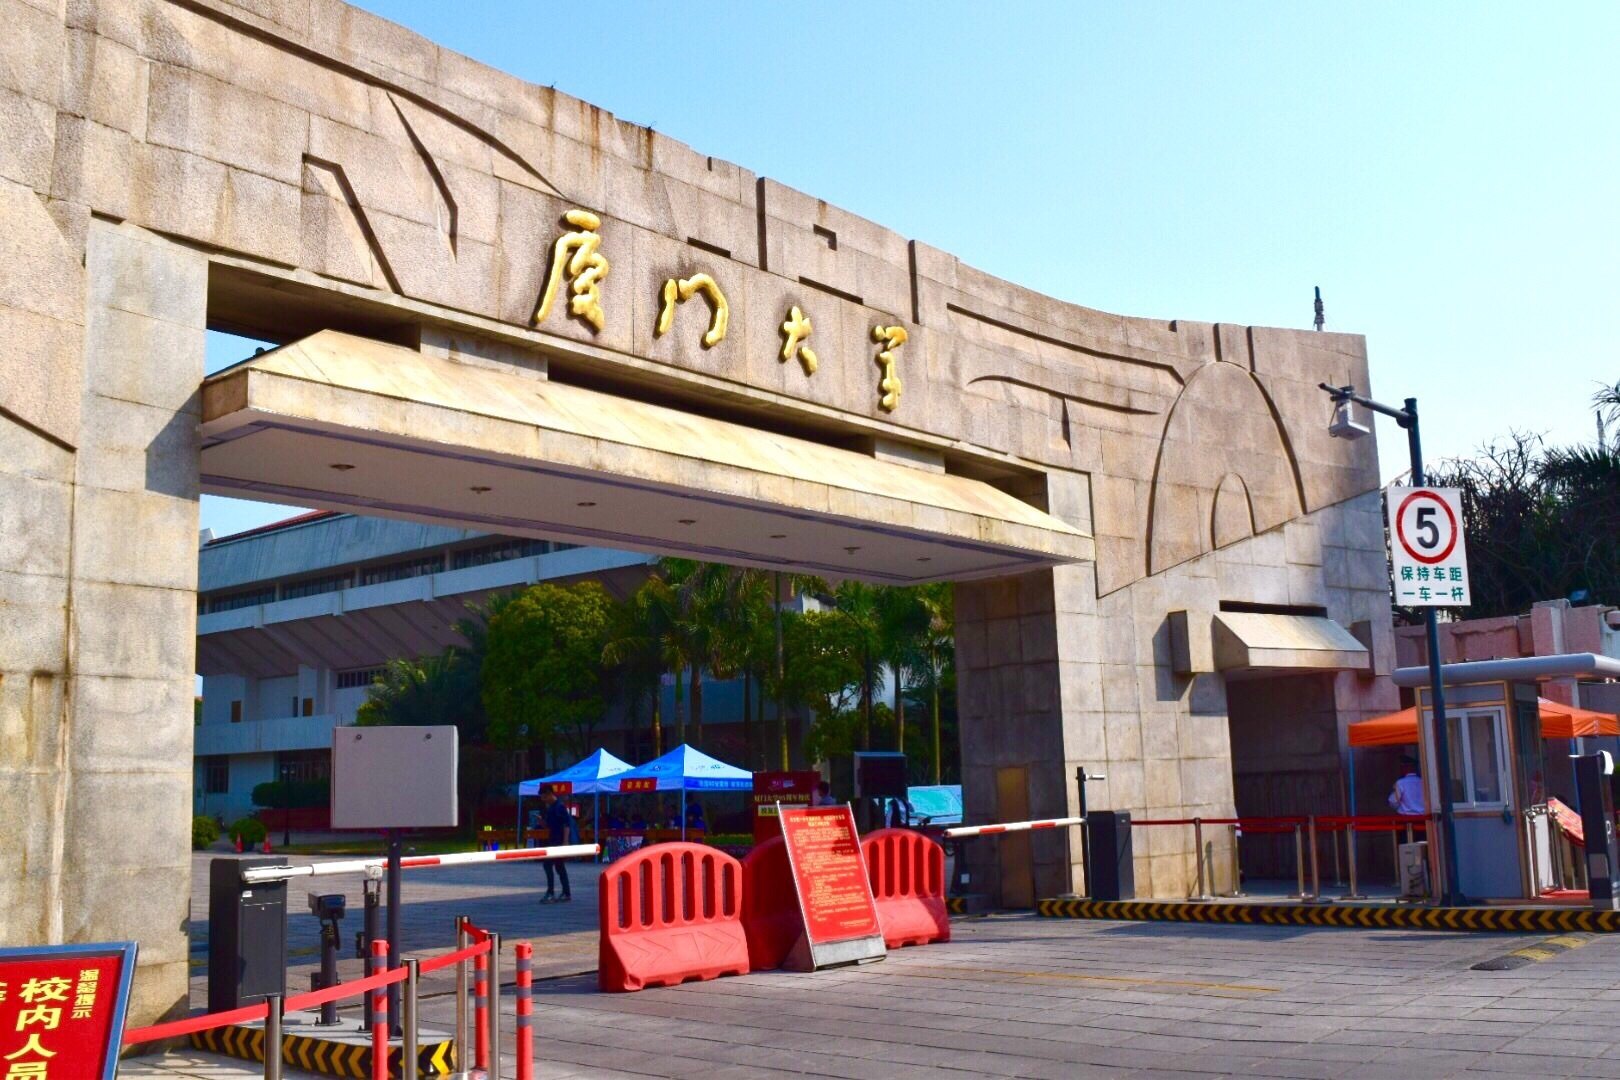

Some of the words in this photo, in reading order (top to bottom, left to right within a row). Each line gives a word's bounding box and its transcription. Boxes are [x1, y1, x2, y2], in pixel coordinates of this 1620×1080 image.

[537, 209, 908, 411] 厦门大学
[1416, 507, 1440, 549] 5
[1401, 566, 1463, 582] 保持车距
[1402, 586, 1464, 602] 一车一杆
[3, 976, 73, 1080] 校内人员
